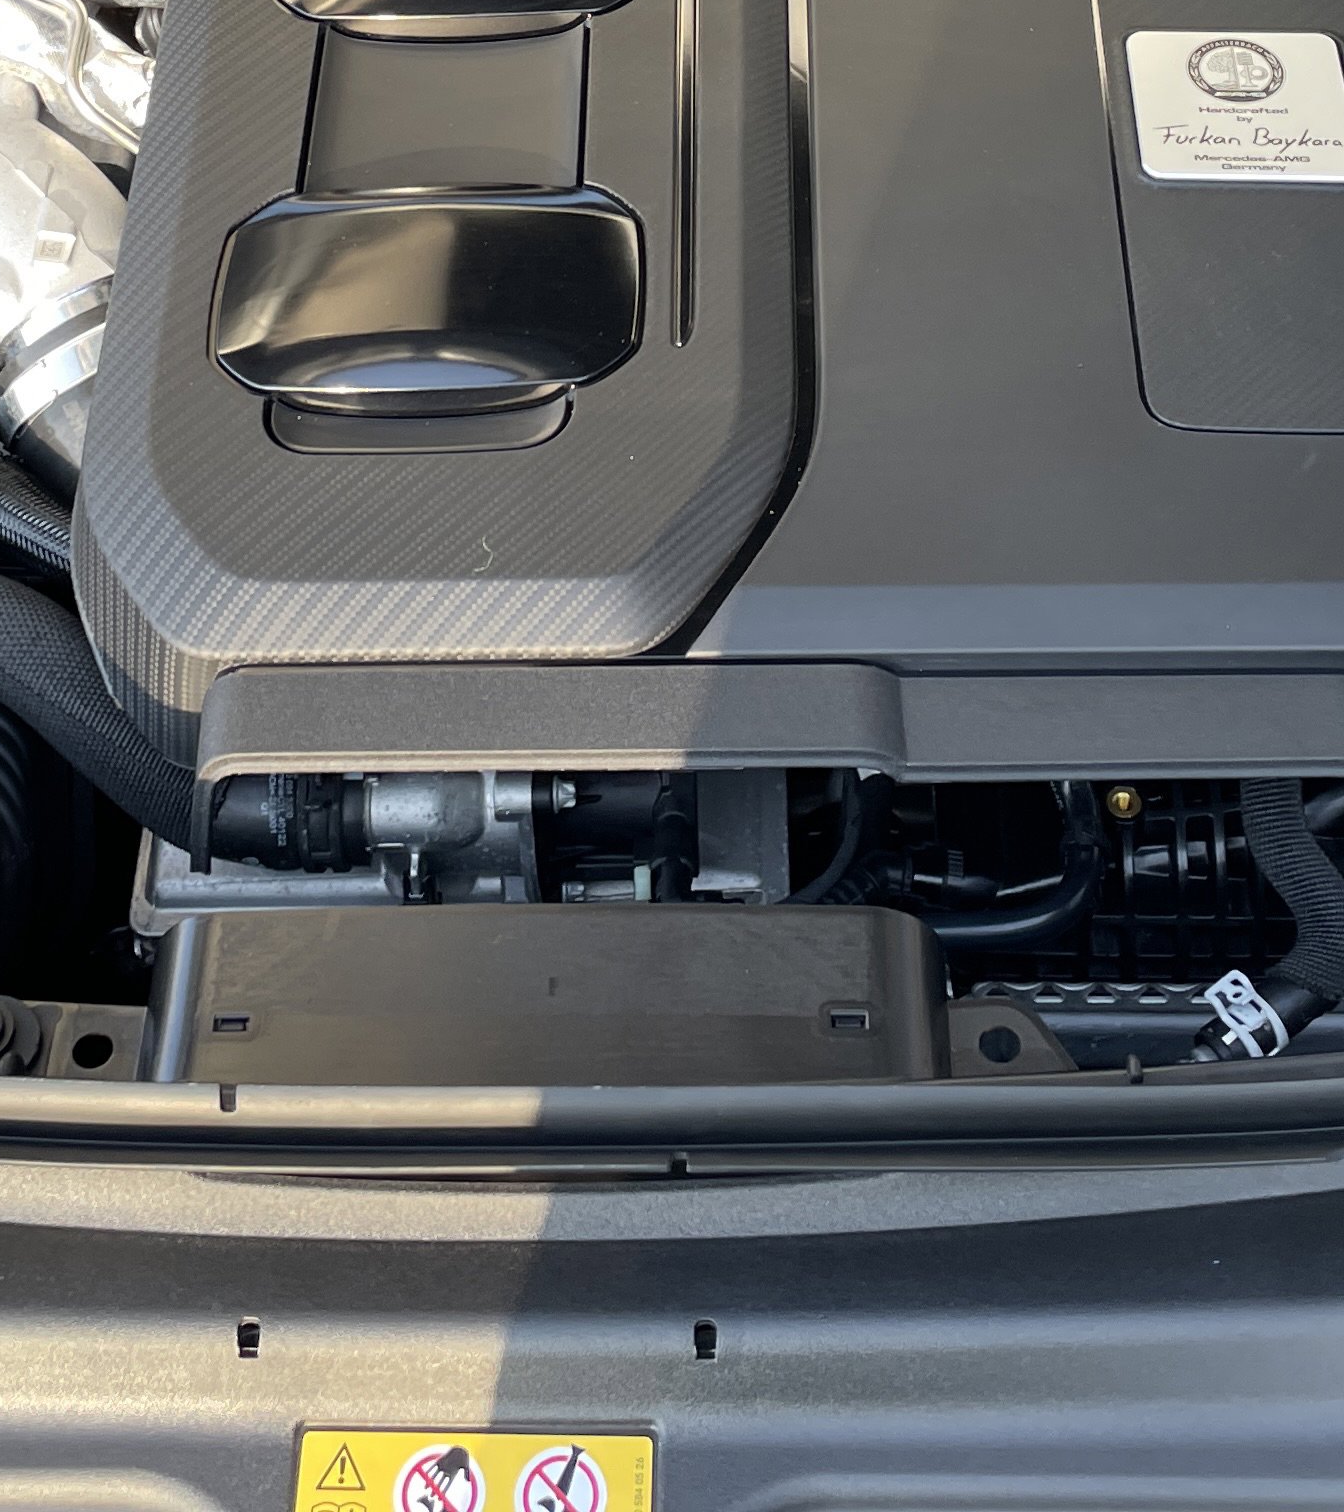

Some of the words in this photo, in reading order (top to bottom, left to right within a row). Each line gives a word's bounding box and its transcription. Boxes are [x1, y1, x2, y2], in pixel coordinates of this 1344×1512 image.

[1198, 106, 1289, 115] Handcrafted
[1236, 115, 1253, 124] by
[1153, 124, 1241, 146] Furkan
[1252, 126, 1344, 154] Baykara
[1194, 154, 1311, 163] Mercedes-AMG
[1221, 162, 1287, 172] Germany
